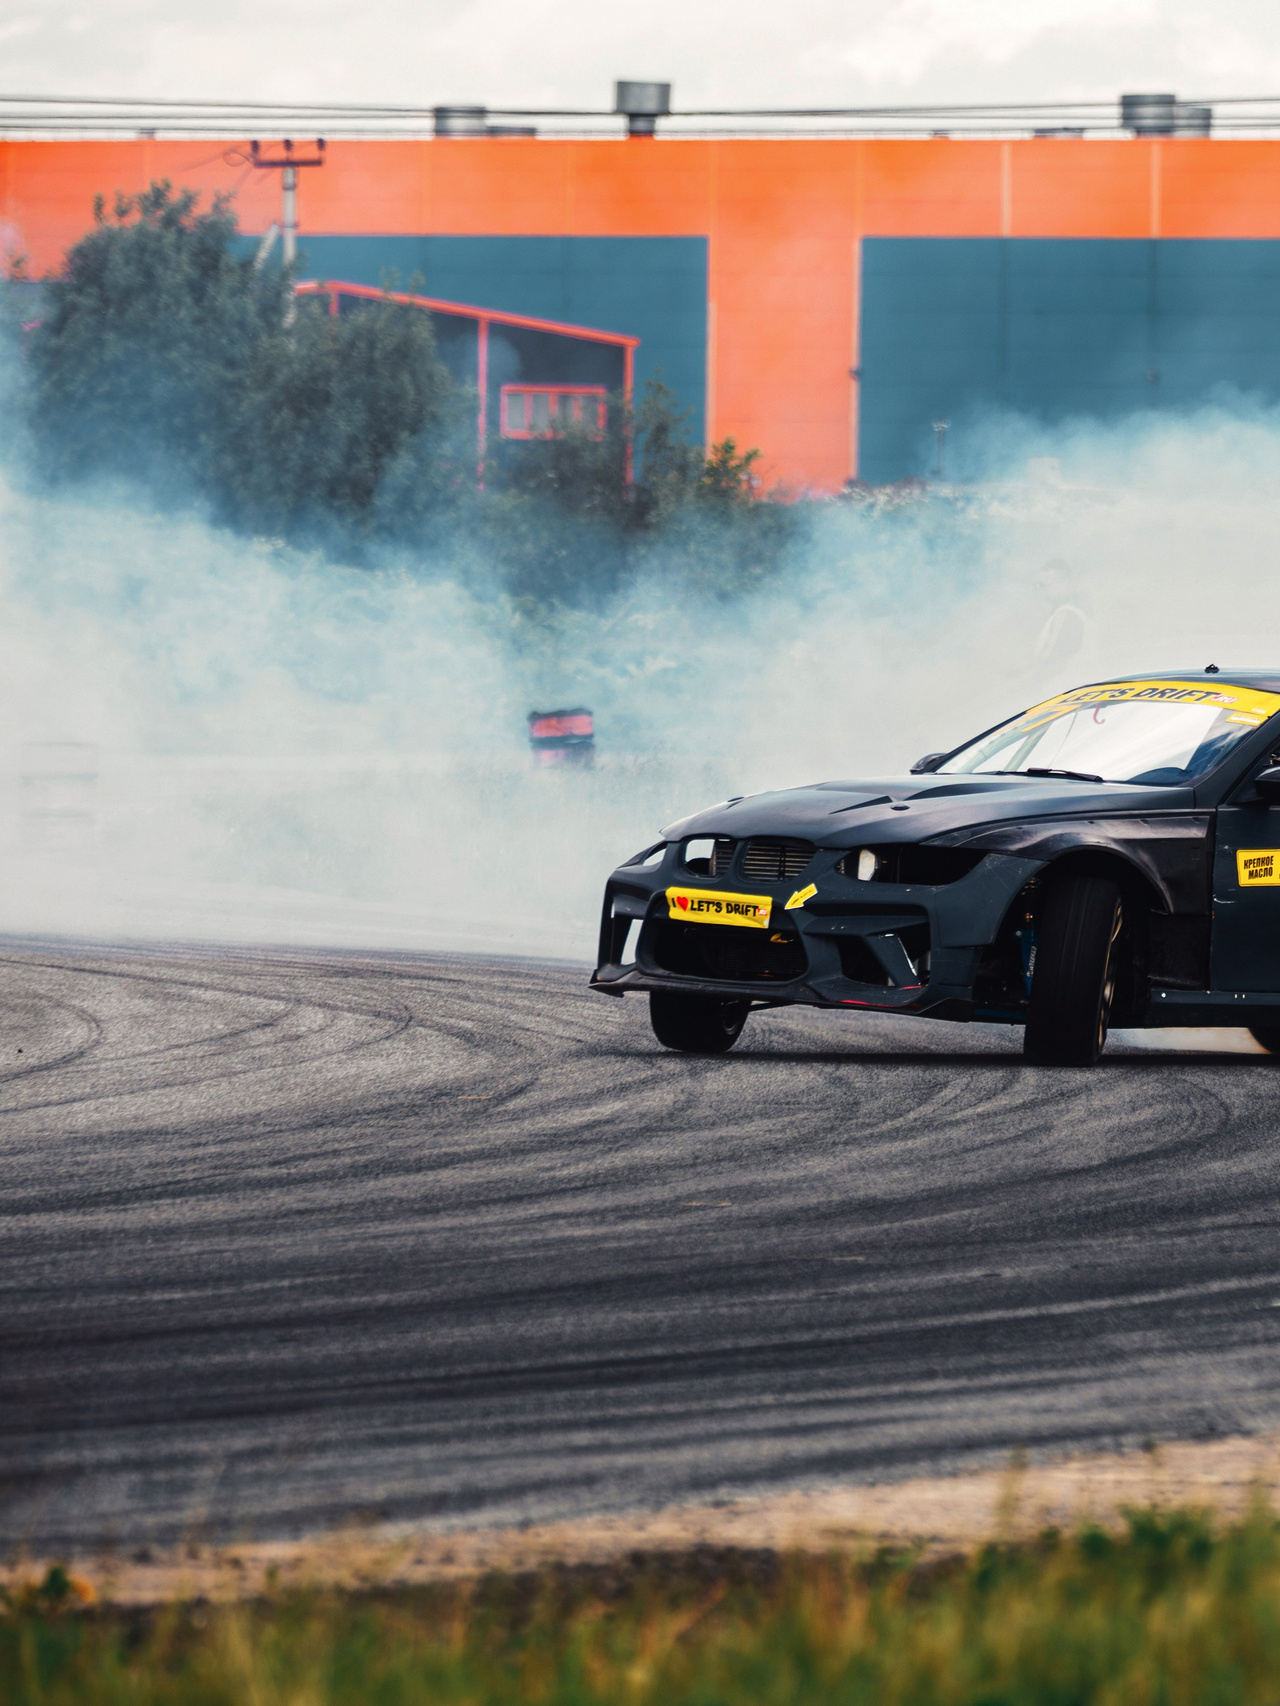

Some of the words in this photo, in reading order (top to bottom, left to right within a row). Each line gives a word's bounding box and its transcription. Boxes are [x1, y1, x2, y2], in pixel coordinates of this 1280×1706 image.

[1058, 688, 1135, 704] LET'S
[1243, 856, 1274, 869] КРЕПКОЕ
[1248, 867, 1273, 880] МАСЛО
[690, 900, 722, 913] LET'S
[726, 903, 759, 917] DRIFT
